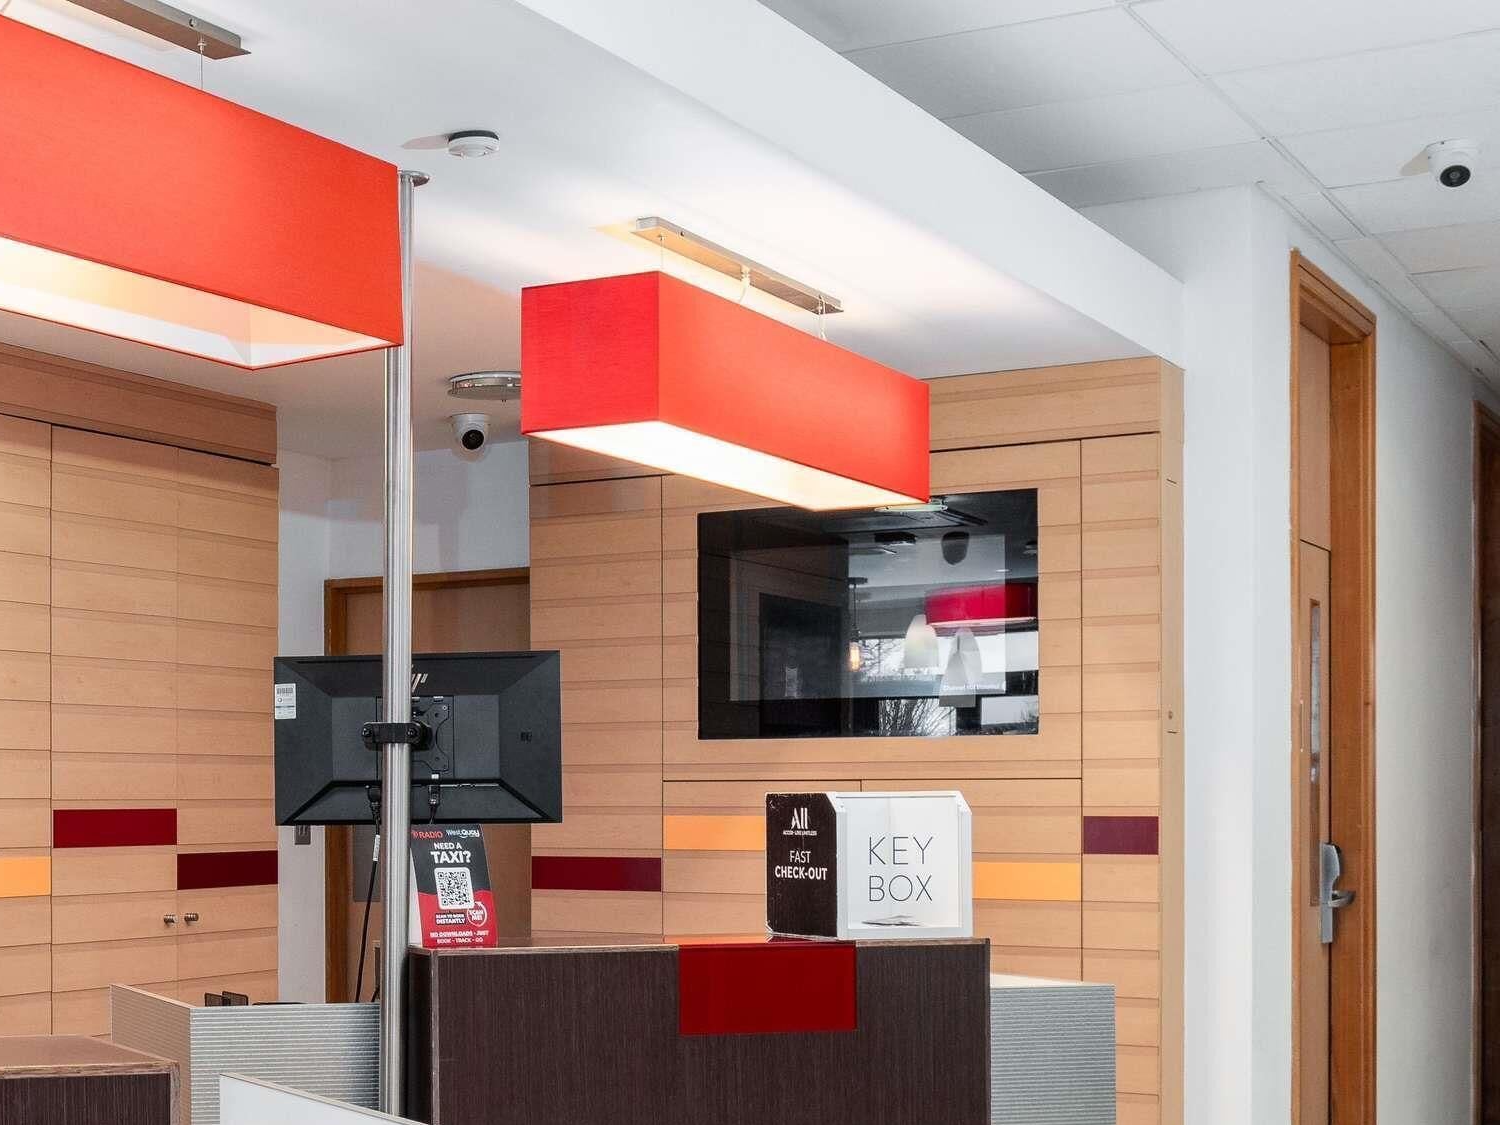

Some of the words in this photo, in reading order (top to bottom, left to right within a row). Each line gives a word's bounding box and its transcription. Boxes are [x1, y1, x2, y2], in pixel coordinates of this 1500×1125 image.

[419, 830, 443, 839] RADIO
[433, 842, 455, 850] NEED
[456, 842, 463, 850] A
[869, 836, 933, 865] KEY
[430, 851, 472, 864] TAXI?
[790, 850, 811, 863] FAST
[775, 865, 828, 880] CHECK-OUT
[869, 875, 933, 902] BOX
